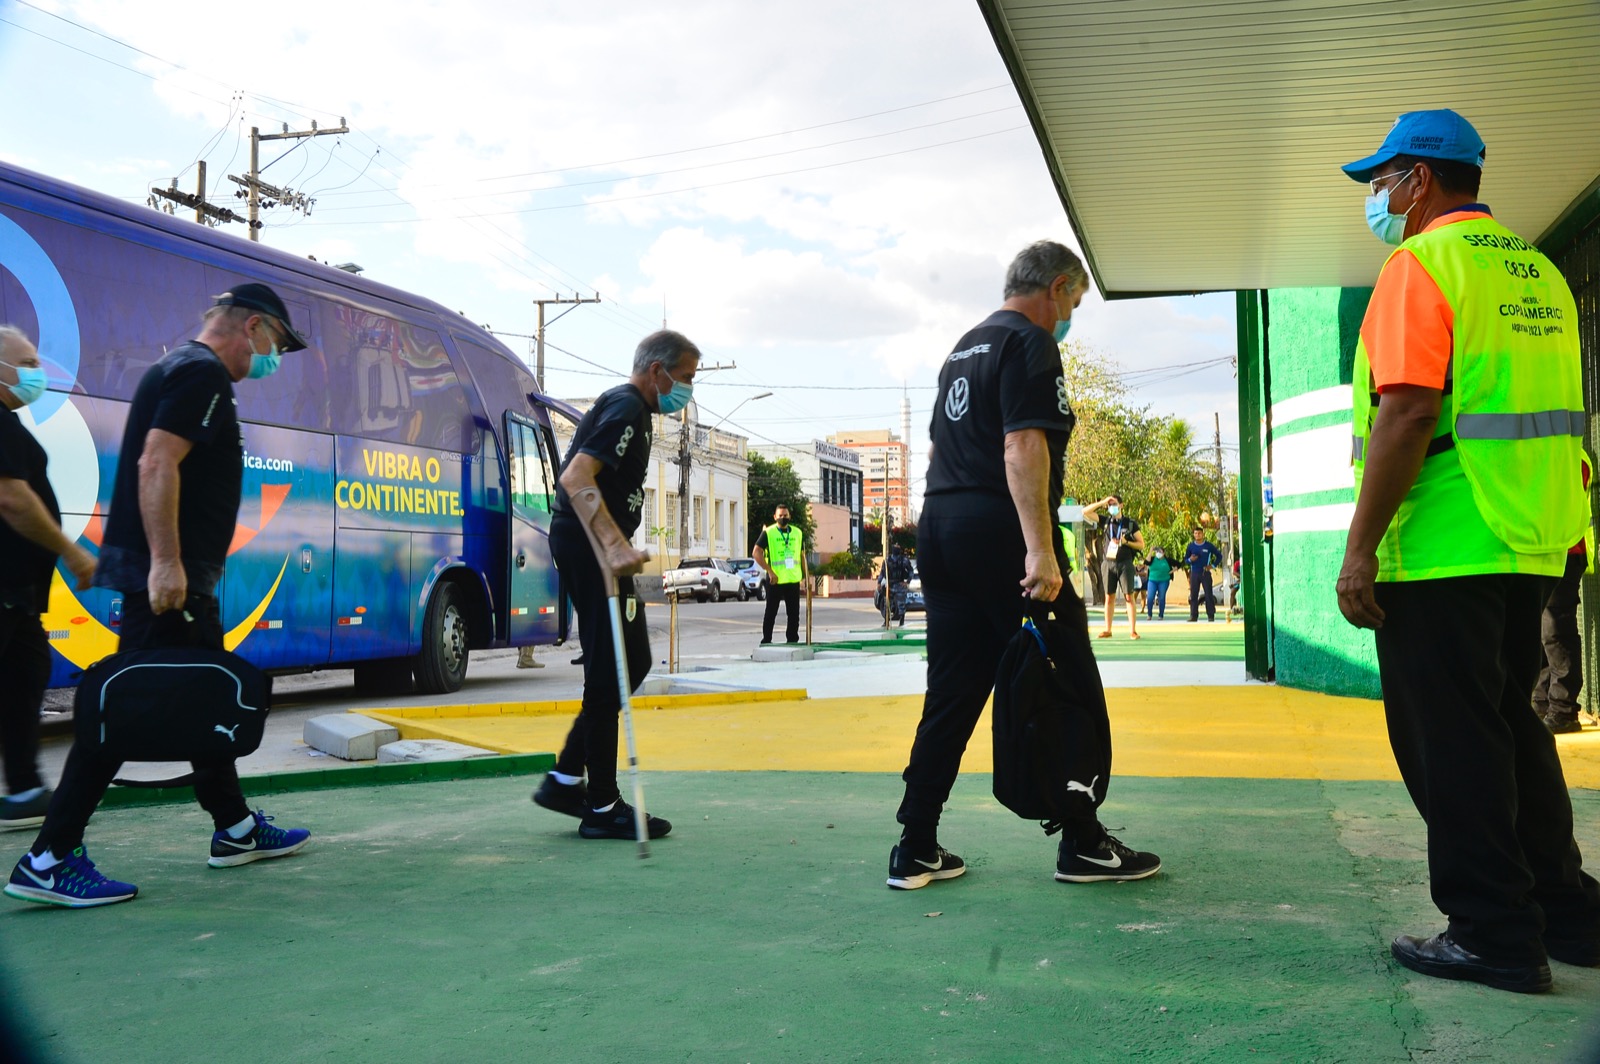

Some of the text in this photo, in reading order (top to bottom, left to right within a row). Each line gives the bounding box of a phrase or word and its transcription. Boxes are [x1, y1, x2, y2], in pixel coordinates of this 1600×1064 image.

[1504, 259, 1540, 279] C836
[242, 450, 293, 472] ica.com
[363, 449, 423, 481] VIBRA
[426, 457, 440, 483] O
[335, 480, 465, 516] CONTINENTE.
